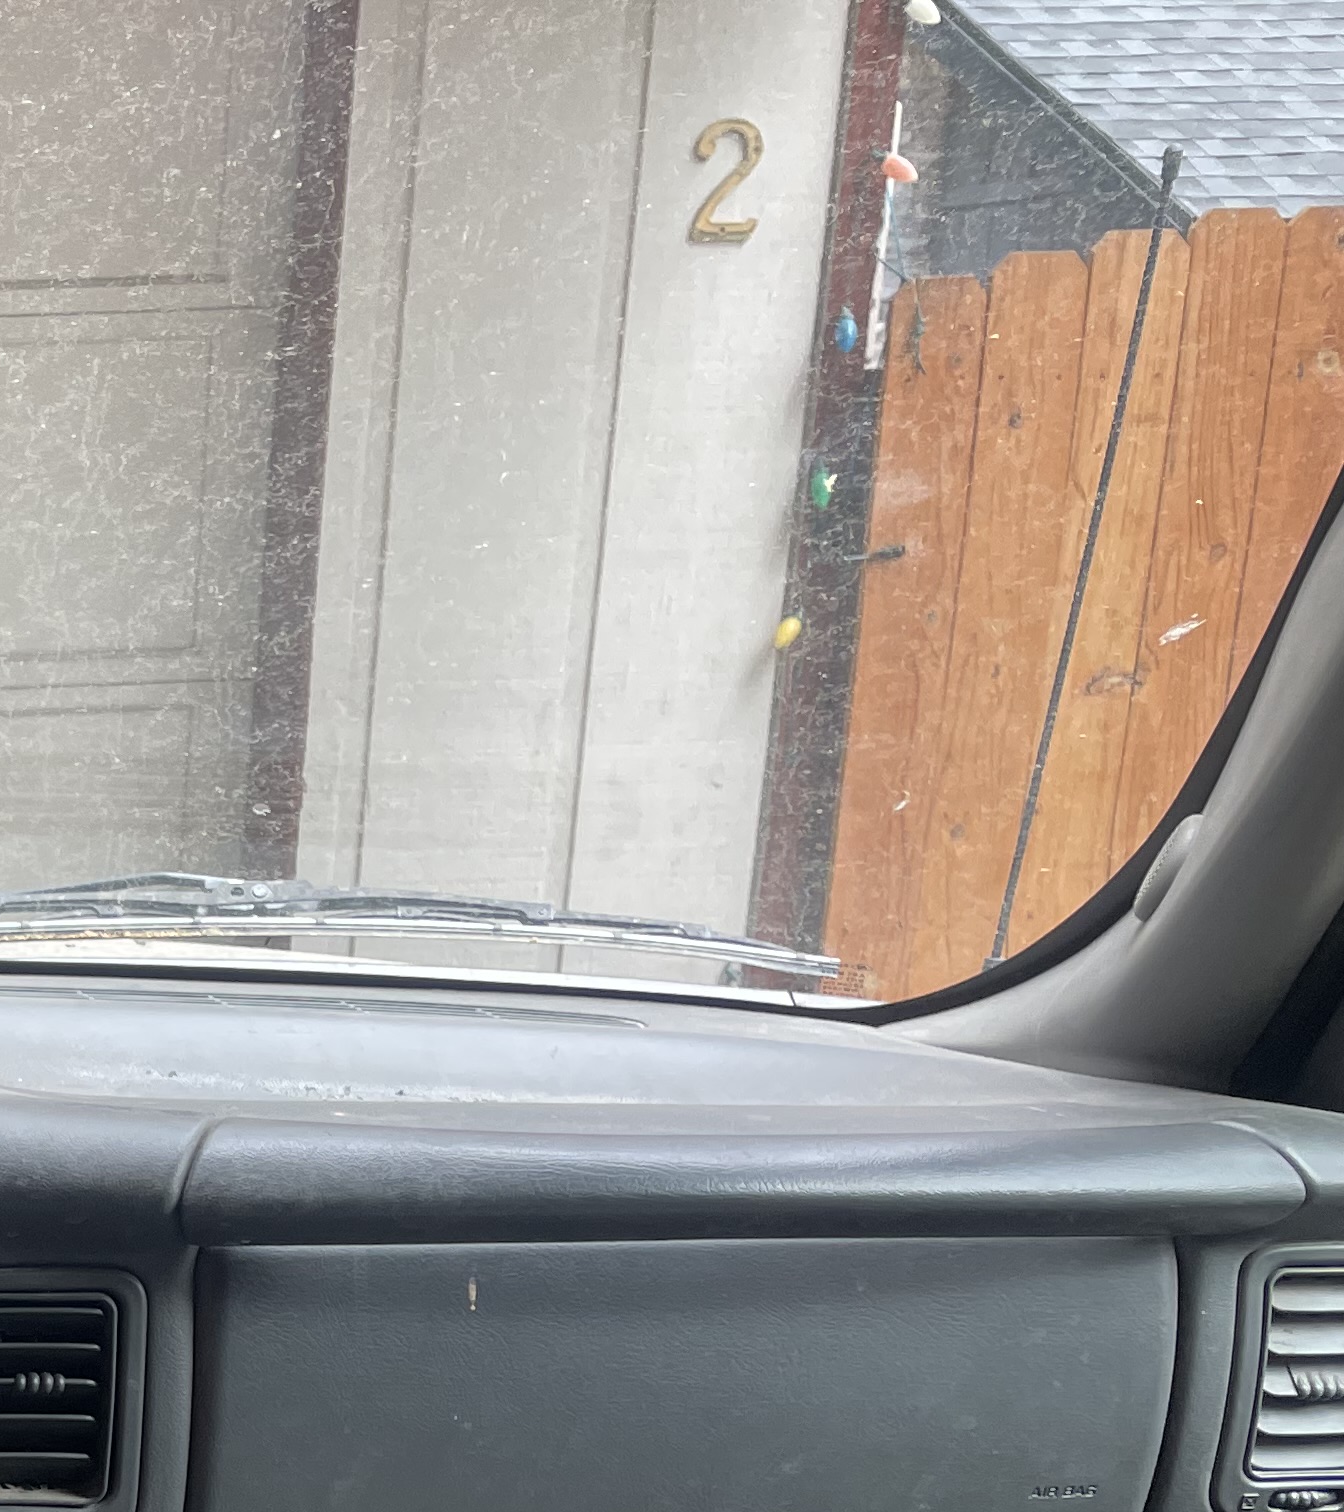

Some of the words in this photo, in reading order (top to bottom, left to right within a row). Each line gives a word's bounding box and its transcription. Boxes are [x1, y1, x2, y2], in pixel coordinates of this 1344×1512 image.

[688, 118, 765, 244] 2
[1030, 1485, 1059, 1500] AIR
[1062, 1484, 1098, 1500] BAG
